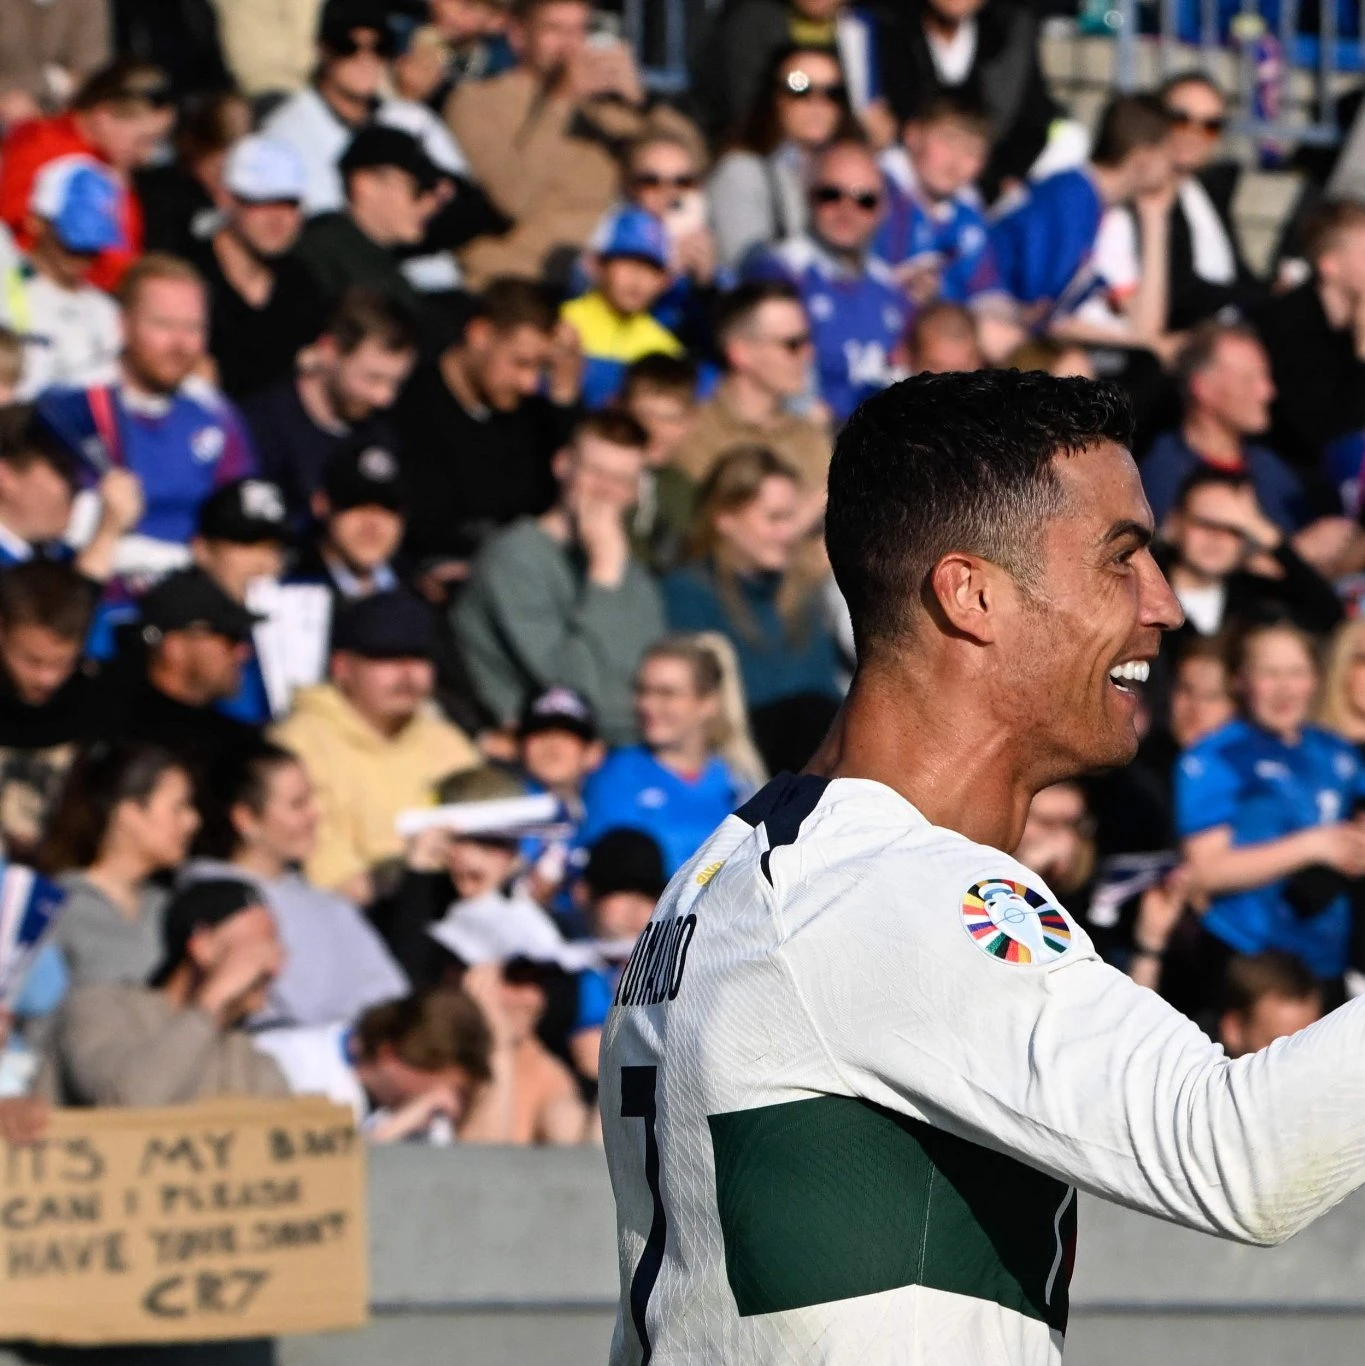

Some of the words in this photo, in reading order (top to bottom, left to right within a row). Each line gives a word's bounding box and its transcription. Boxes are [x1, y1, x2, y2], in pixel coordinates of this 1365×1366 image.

[137, 1132, 236, 1177] MY
[1, 1196, 102, 1229] CAN
[7, 1231, 128, 1279] HAVE
[143, 1269, 270, 1319] CR7
